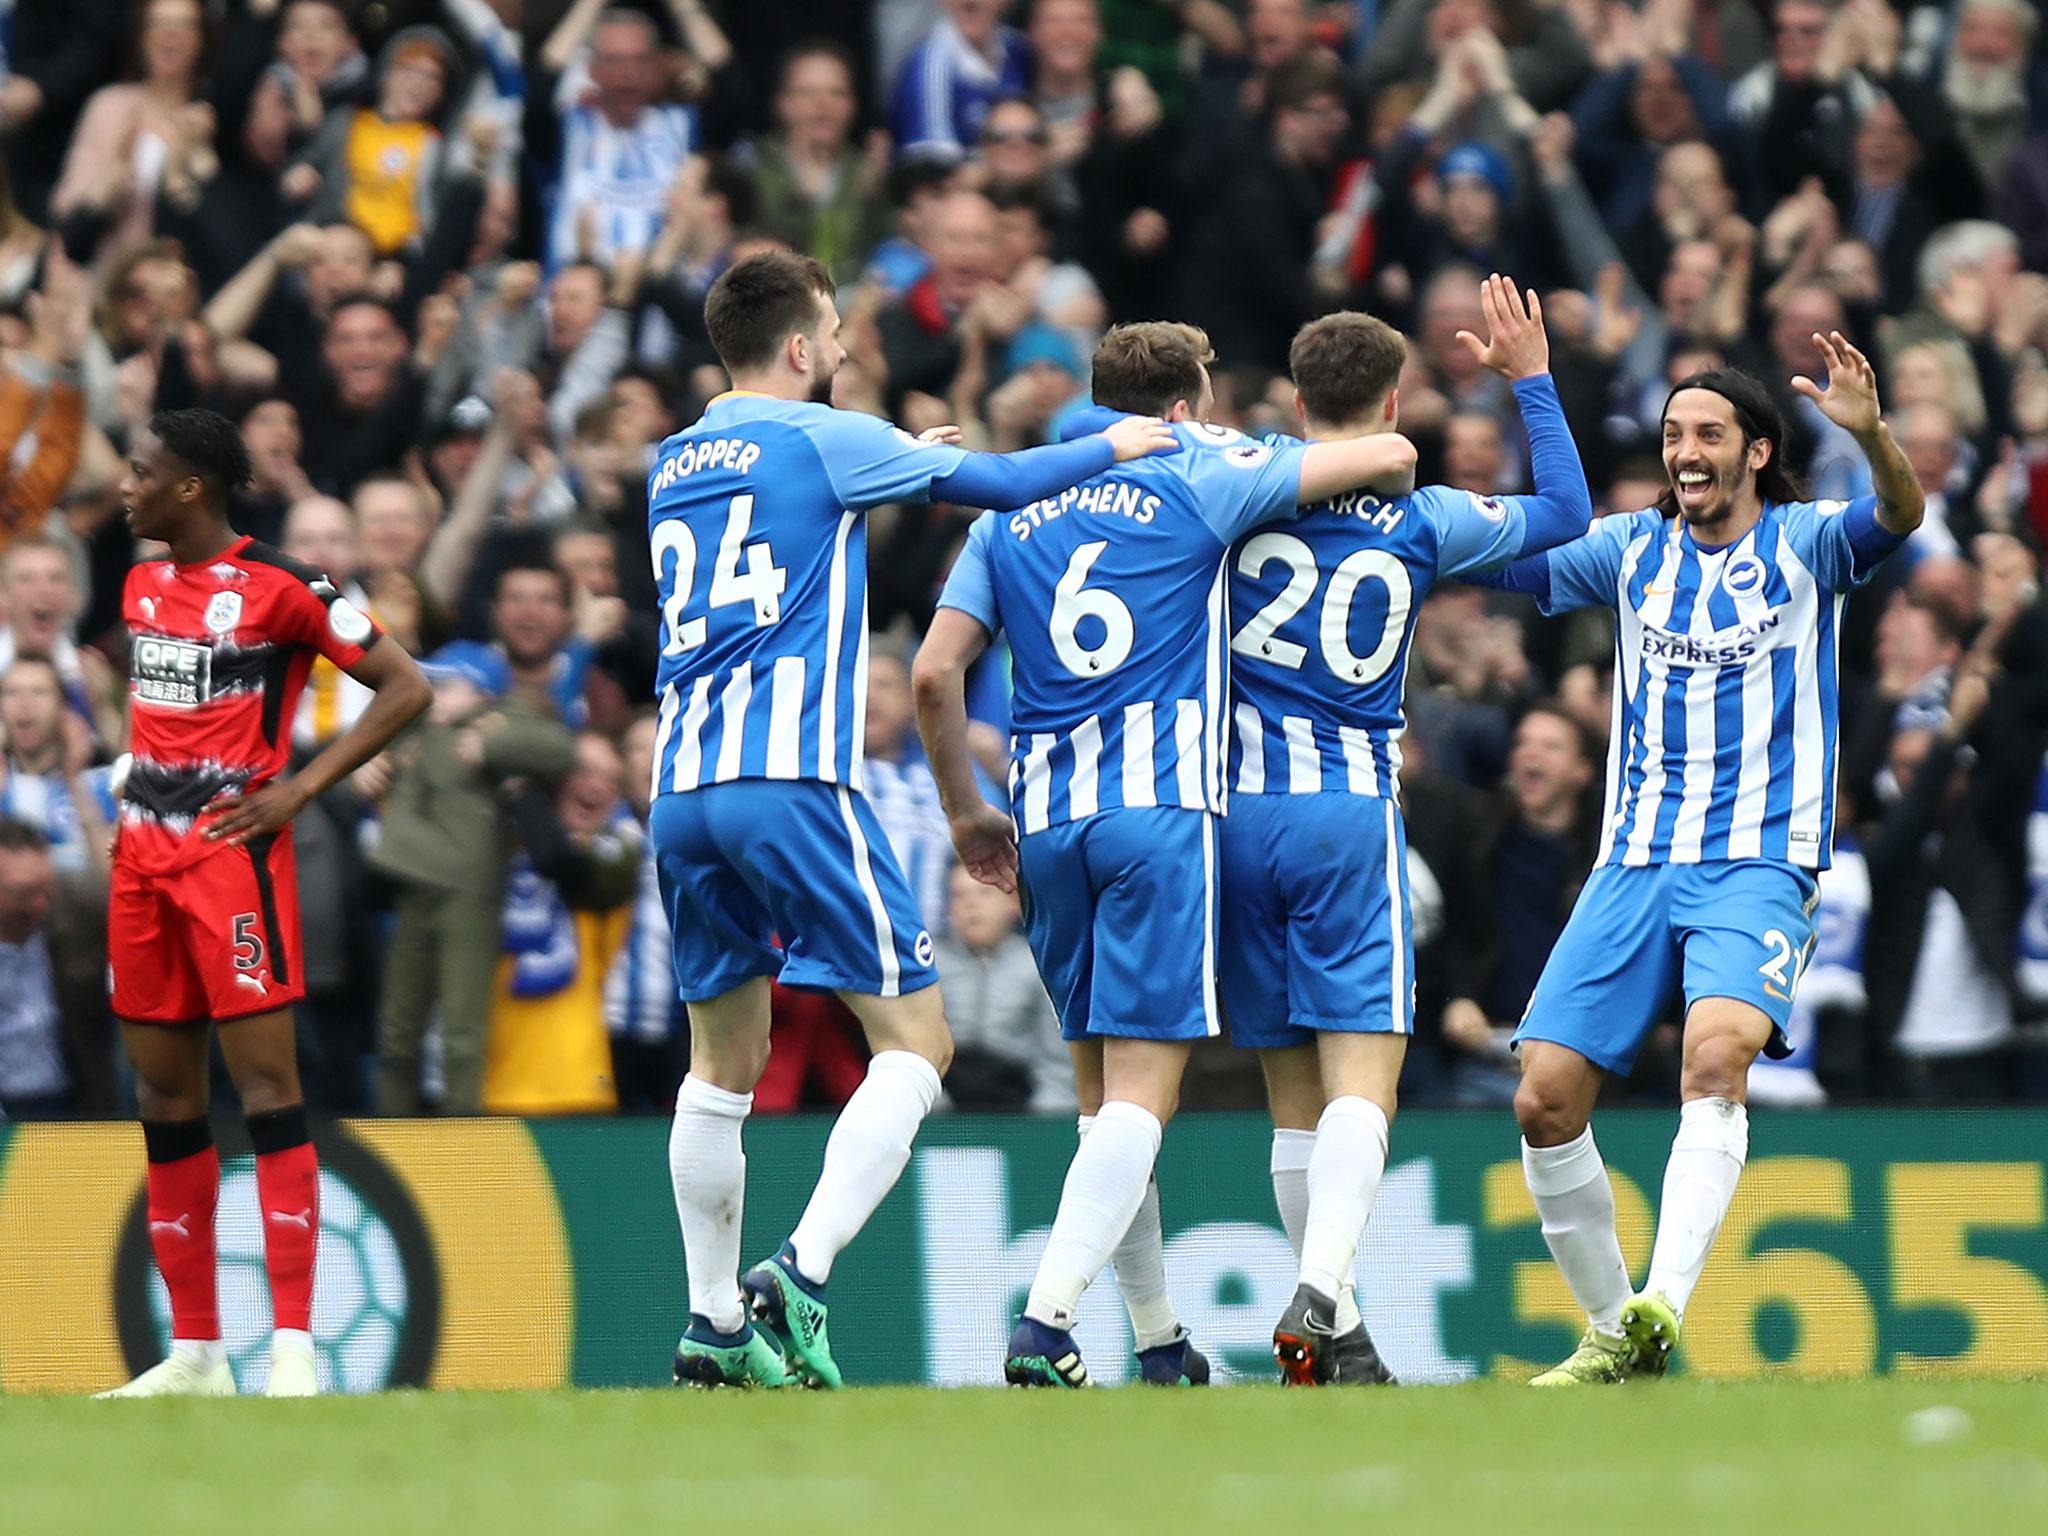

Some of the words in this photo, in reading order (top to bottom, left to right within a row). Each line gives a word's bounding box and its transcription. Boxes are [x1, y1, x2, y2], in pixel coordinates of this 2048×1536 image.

[651, 439, 761, 500] PRÖPPER
[1009, 482, 1162, 542] STEPHENS
[650, 494, 787, 656] 24
[1049, 540, 1135, 678] 6
[1230, 532, 1413, 685] 20
[141, 642, 200, 670] OPE
[1643, 641, 1756, 664] EXPRESS
[232, 912, 264, 970] 5
